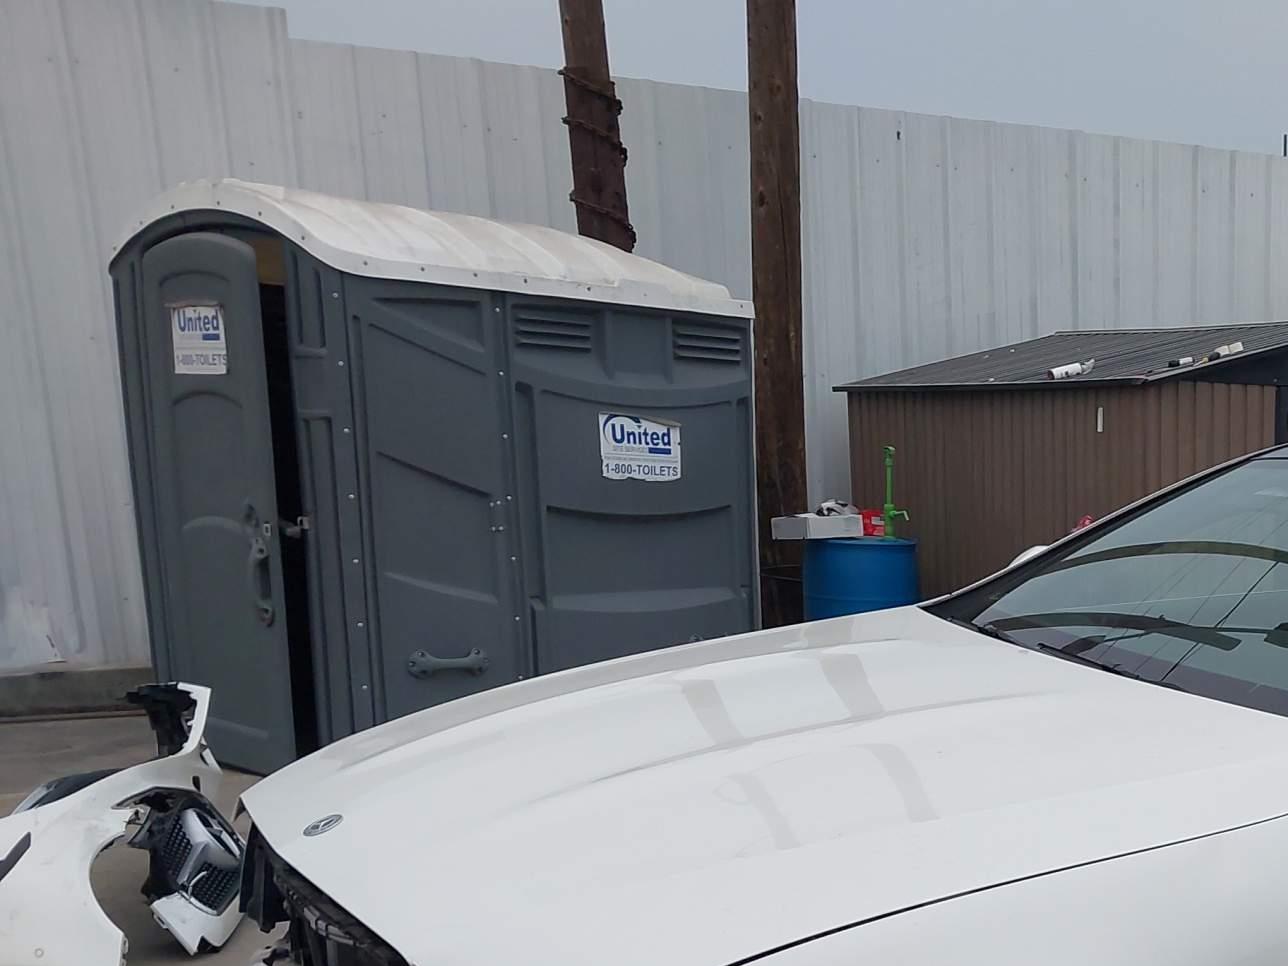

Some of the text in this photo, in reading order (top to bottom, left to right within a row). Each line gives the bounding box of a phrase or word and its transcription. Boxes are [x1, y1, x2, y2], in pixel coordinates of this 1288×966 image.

[177, 309, 220, 332] United
[611, 423, 672, 447] United
[605, 463, 679, 477] 1-800-TOILETS
